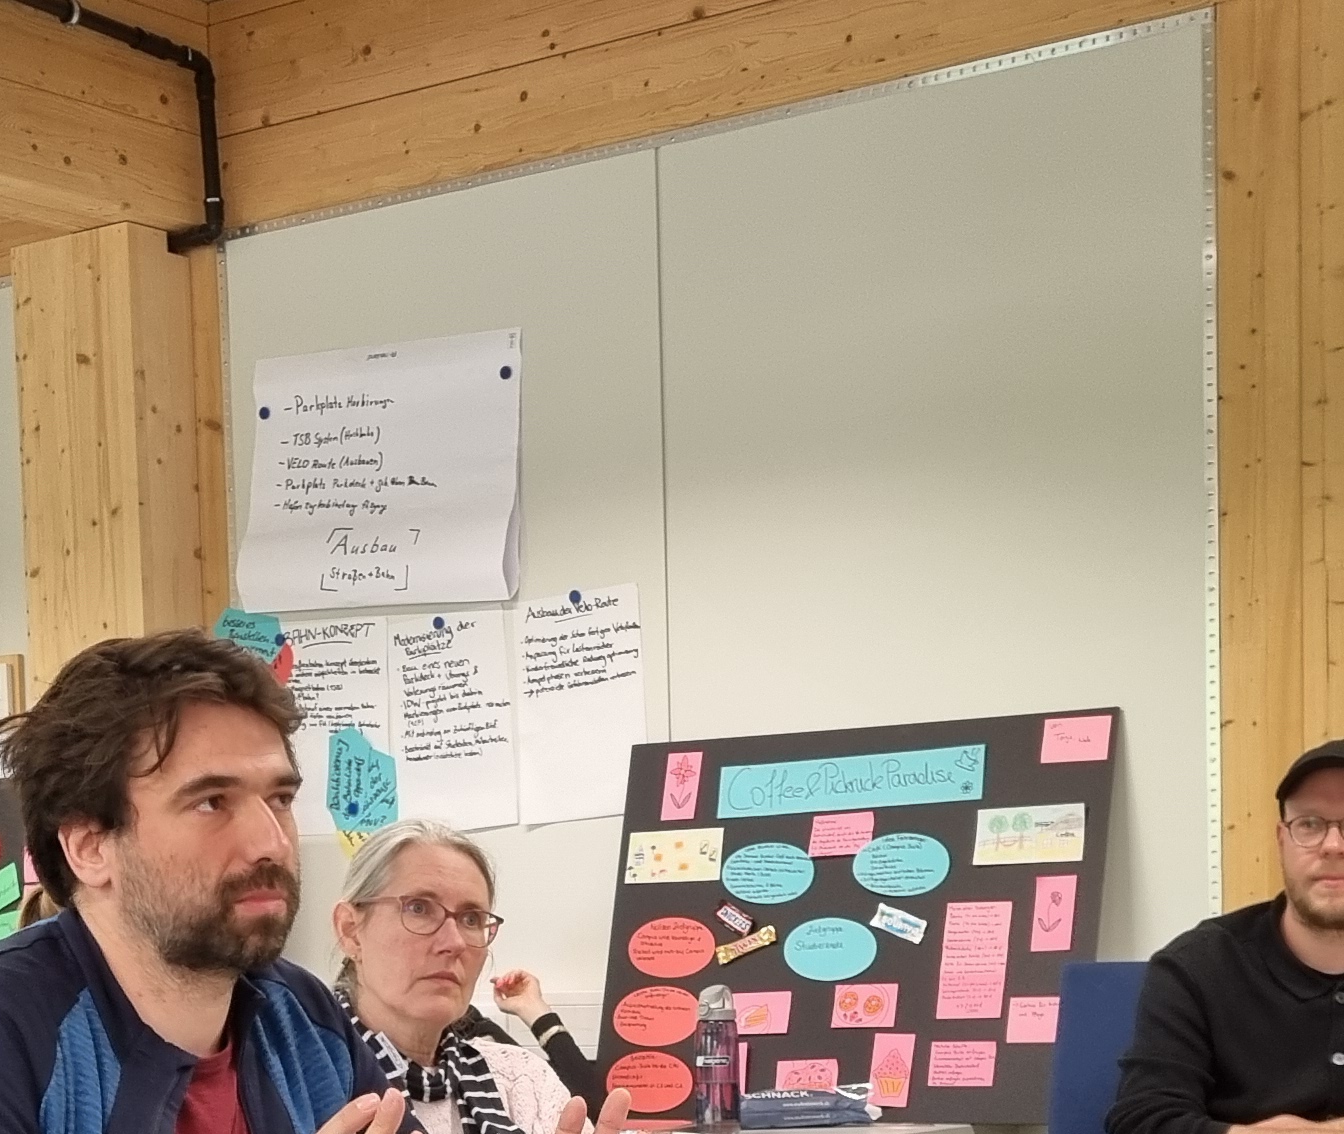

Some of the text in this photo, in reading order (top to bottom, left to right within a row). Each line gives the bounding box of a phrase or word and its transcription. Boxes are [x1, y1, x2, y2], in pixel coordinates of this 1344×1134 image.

[330, 533, 397, 556] Ausbau
[457, 620, 476, 631] der
[727, 766, 806, 810] Coffee
[883, 758, 955, 790] Paradise
